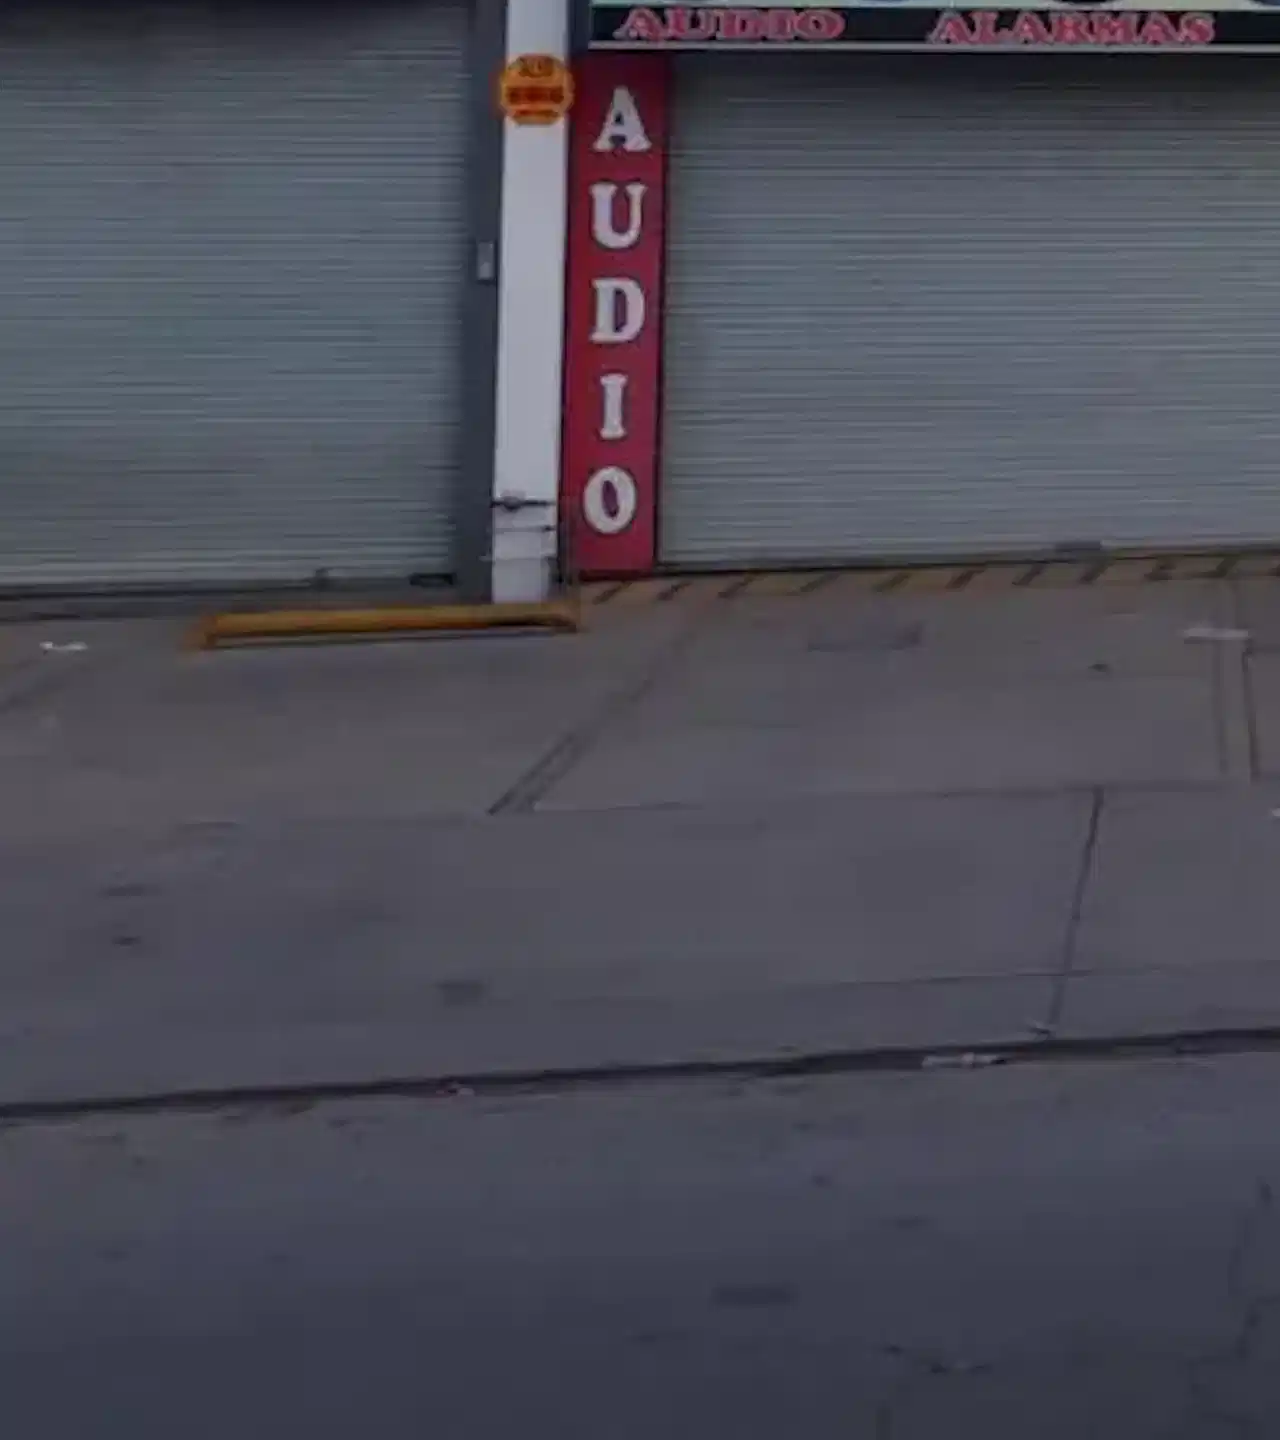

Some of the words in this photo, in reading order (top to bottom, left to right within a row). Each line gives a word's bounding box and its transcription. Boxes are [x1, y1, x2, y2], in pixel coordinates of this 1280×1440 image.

[614, 7, 846, 42] AUDIO
[926, 10, 1216, 47] ALARMAS
[583, 85, 653, 534] AUDIO
